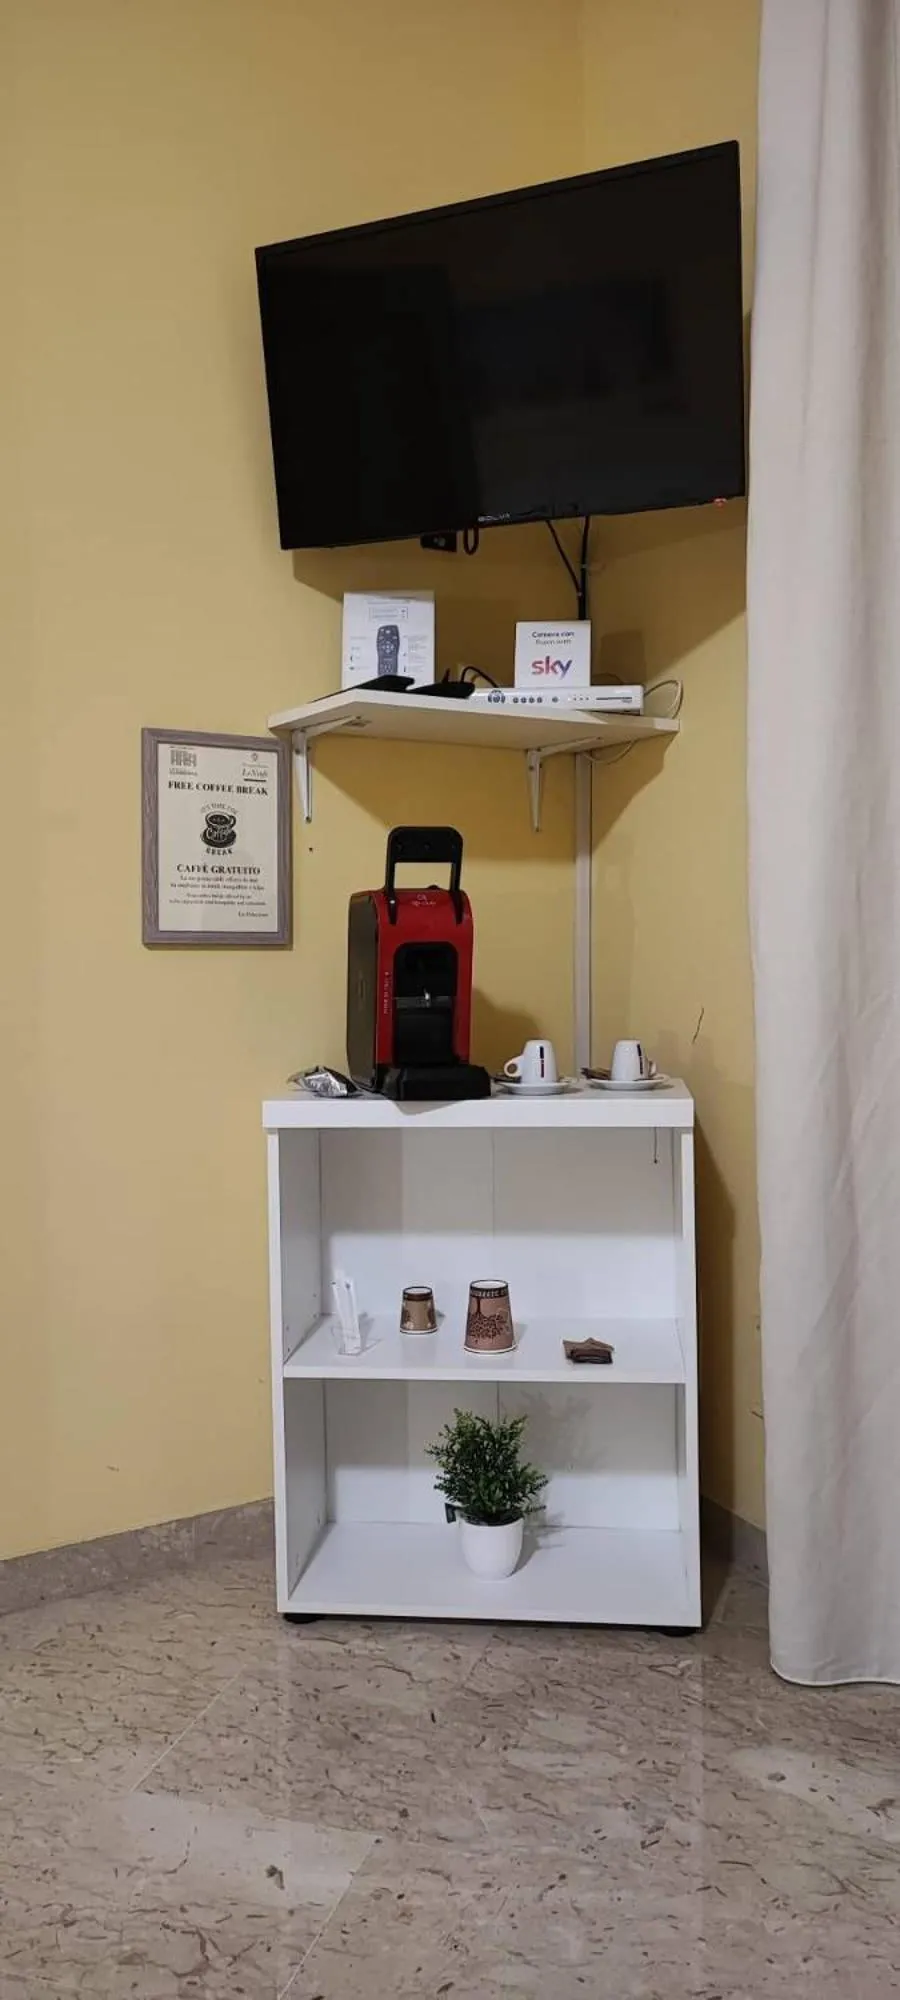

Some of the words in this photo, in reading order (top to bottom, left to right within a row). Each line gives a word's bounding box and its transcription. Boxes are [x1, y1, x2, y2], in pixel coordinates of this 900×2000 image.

[531, 655, 573, 680] sky
[168, 780, 194, 791] FREE
[195, 783, 234, 794] COFFEE
[236, 785, 269, 796] BREAK
[210, 865, 261, 875] GRATUITO
